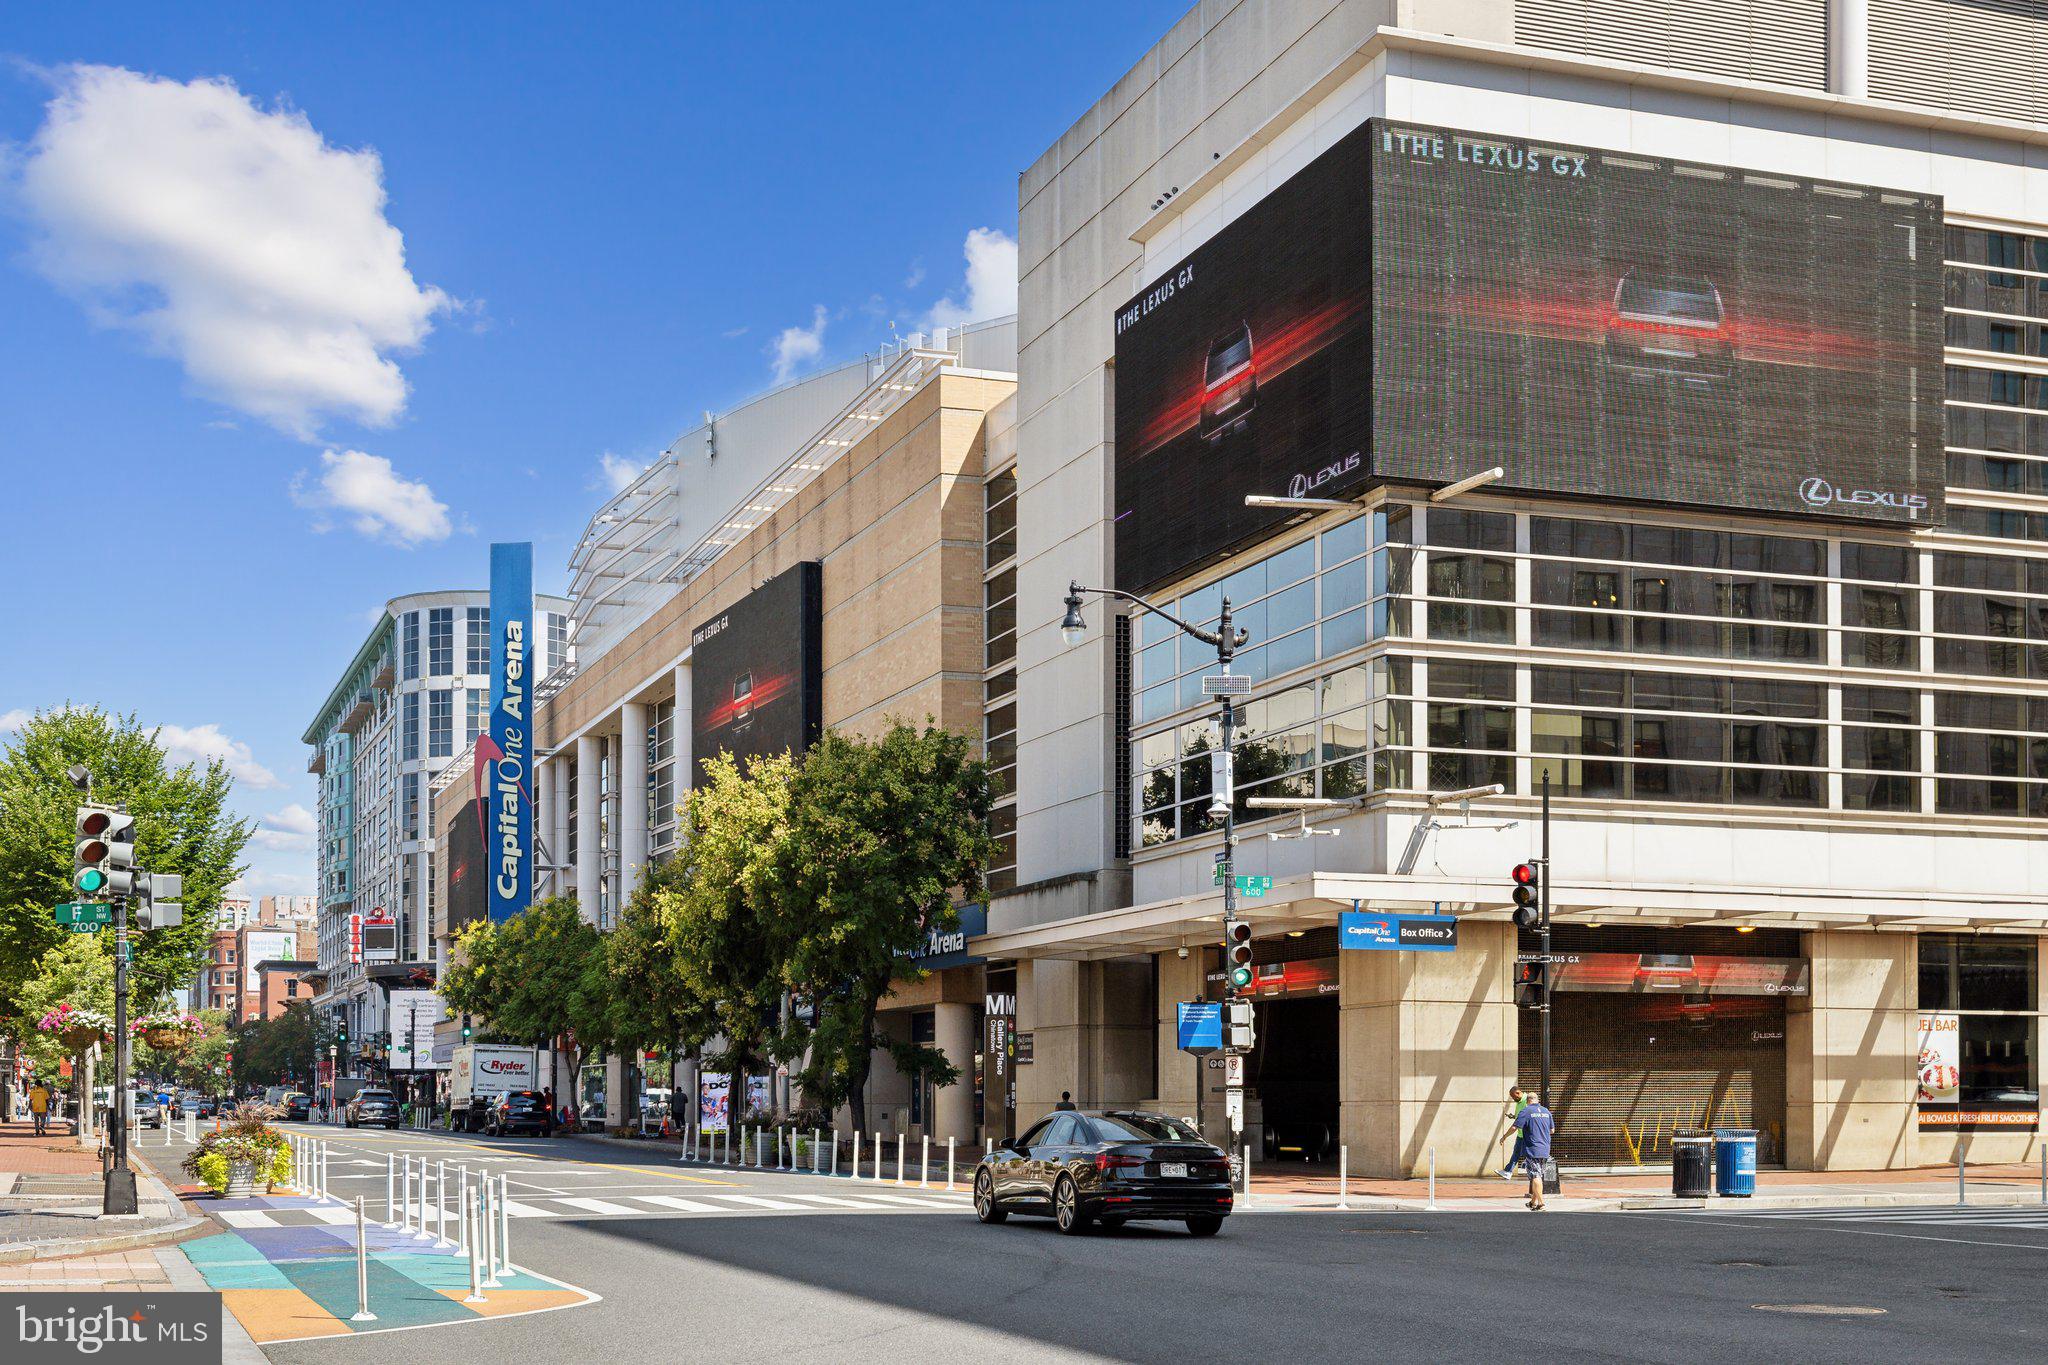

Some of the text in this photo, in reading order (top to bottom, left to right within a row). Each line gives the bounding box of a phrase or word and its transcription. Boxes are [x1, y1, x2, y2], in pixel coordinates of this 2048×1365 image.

[1397, 134, 1587, 177] THE LEXUS GX
[1122, 264, 1194, 331] THE LEXUS GX
[1308, 451, 1360, 490] LEXUS
[1836, 488, 1928, 509] LEXUS
[705, 620, 720, 640] LEXUS
[502, 619, 524, 721] Arena
[1247, 877, 1255, 887] F
[1245, 888, 1261, 897] 600
[72, 906, 83, 920] F
[71, 922, 98, 932] 700
[1400, 928, 1444, 938] Box Office
[929, 932, 964, 956] Arena
[1567, 955, 1580, 963] GX
[983, 994, 1005, 1015] M
[1935, 1019, 1958, 1031] BAR
[996, 1019, 1005, 1076] Gallery Place
[490, 1060, 526, 1072] Ryder
[1926, 1114, 1952, 1122] BOWLS
[1959, 1114, 1981, 1122] FRESH
[1981, 1114, 1999, 1122] FRUIT
[1999, 1114, 2038, 1122] SMOOTHIES
